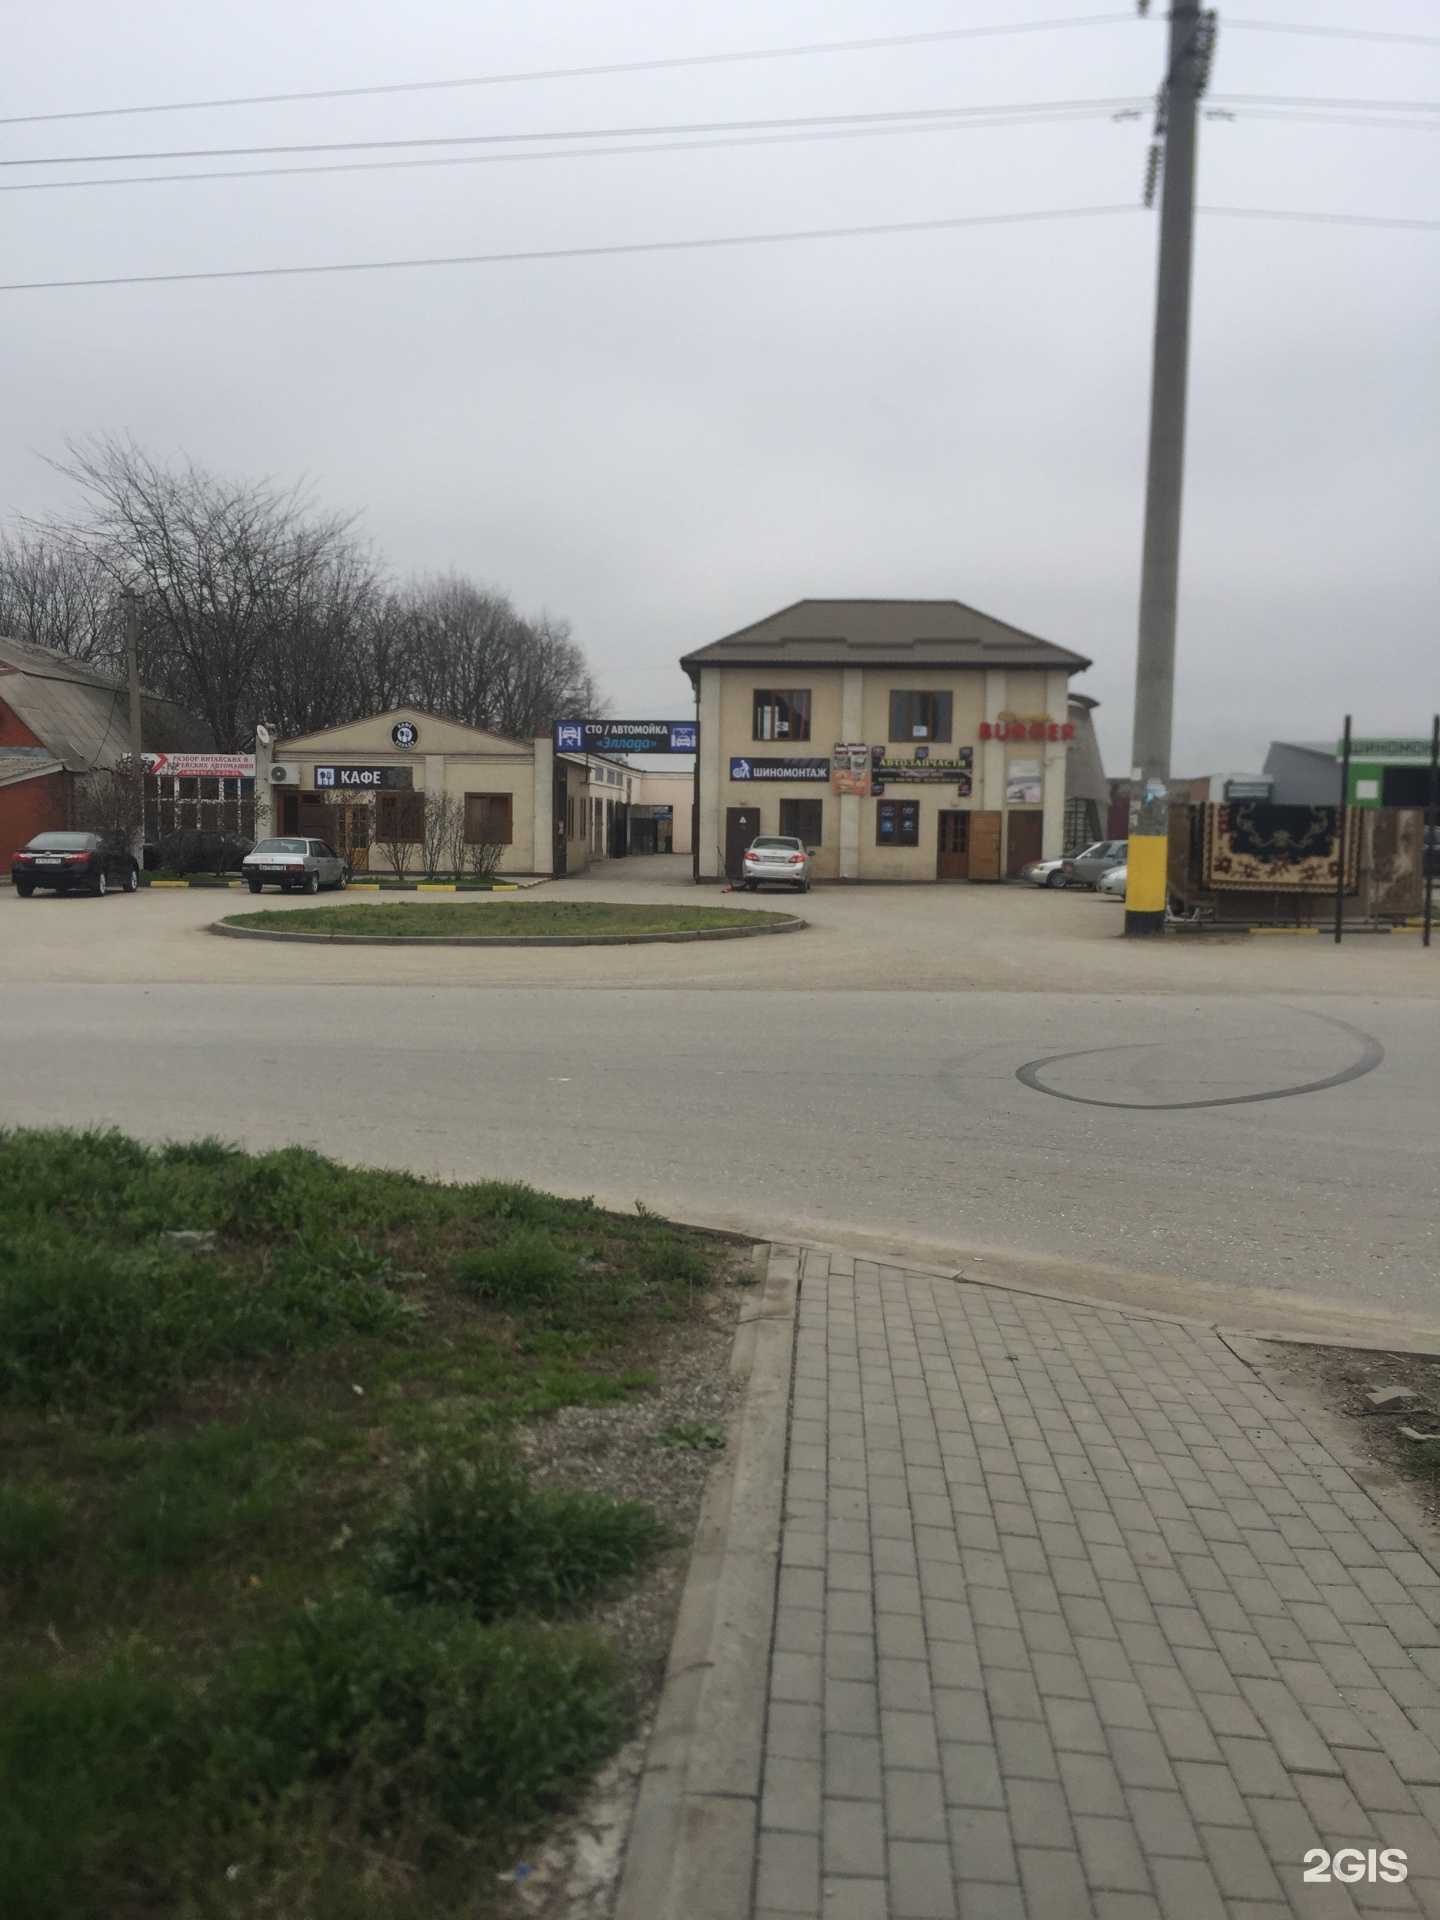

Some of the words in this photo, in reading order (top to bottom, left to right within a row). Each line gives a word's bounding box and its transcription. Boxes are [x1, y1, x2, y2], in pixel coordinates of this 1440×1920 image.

[585, 725, 602, 735] СТО
[611, 723, 668, 735] АВТОМОЙКА
[879, 758, 966, 768] АВТОЗАПЧАСТИ
[341, 770, 382, 785] КАФЕ
[753, 767, 828, 778] ШИНОМОНТАЖ
